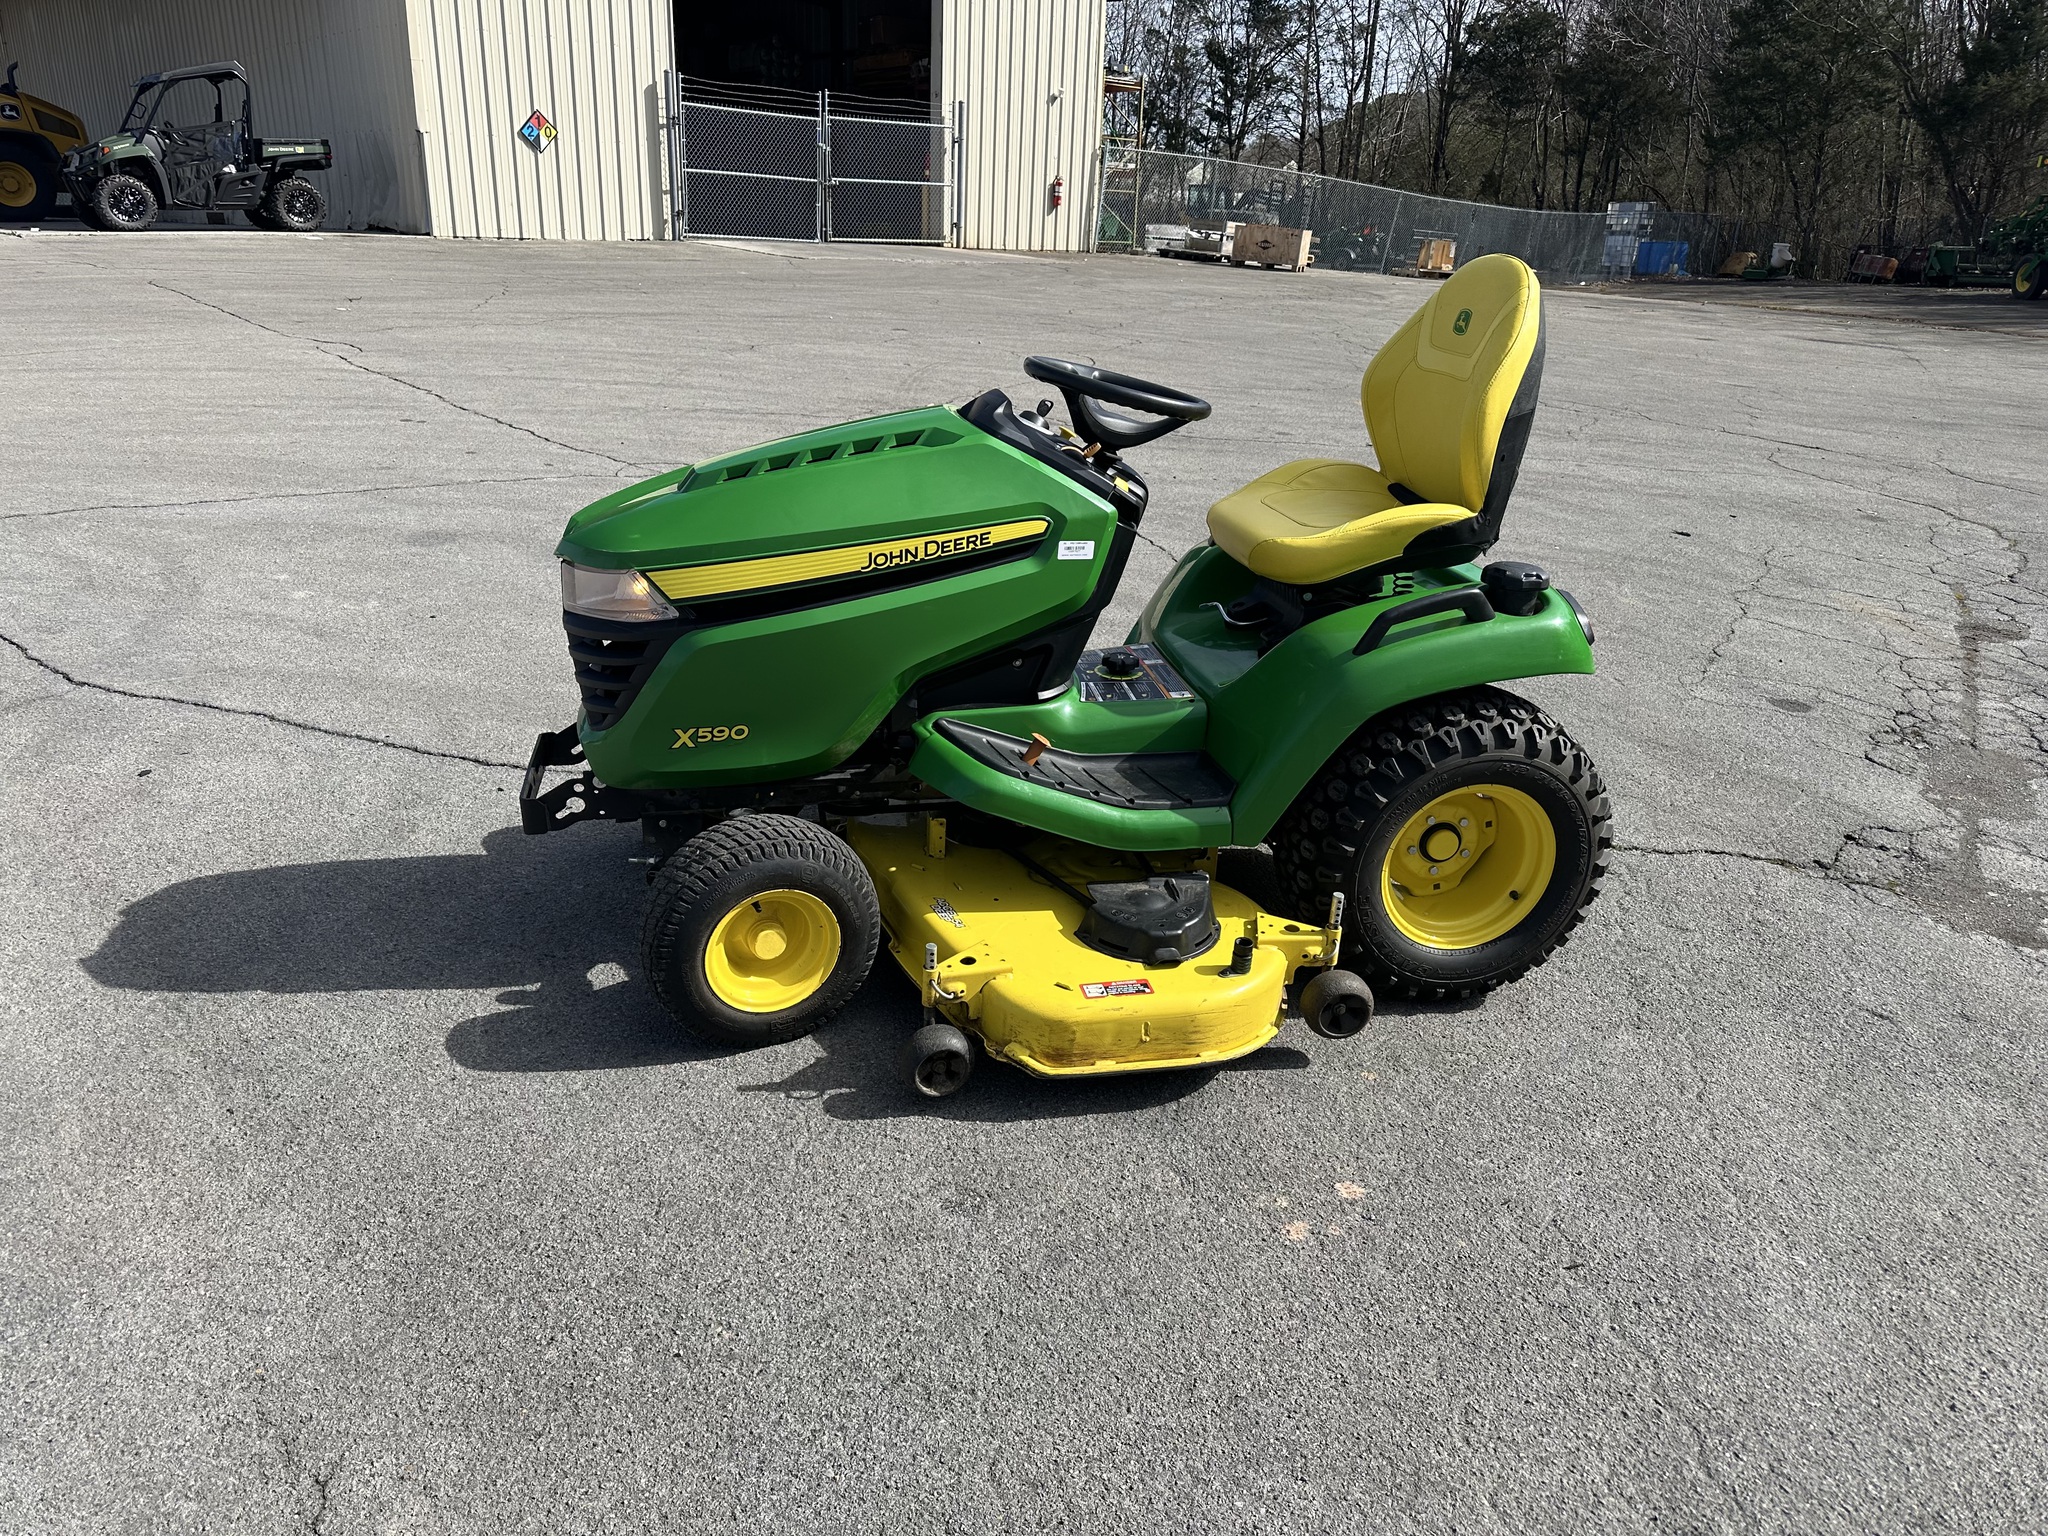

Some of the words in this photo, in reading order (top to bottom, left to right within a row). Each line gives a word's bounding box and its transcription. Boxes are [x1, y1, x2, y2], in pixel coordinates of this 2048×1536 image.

[534, 114, 541, 128] 1
[526, 124, 535, 138] 2
[544, 125, 552, 139] 0
[860, 546, 919, 572] JOHN
[923, 531, 993, 559] DEERE
[670, 724, 750, 749] X590
